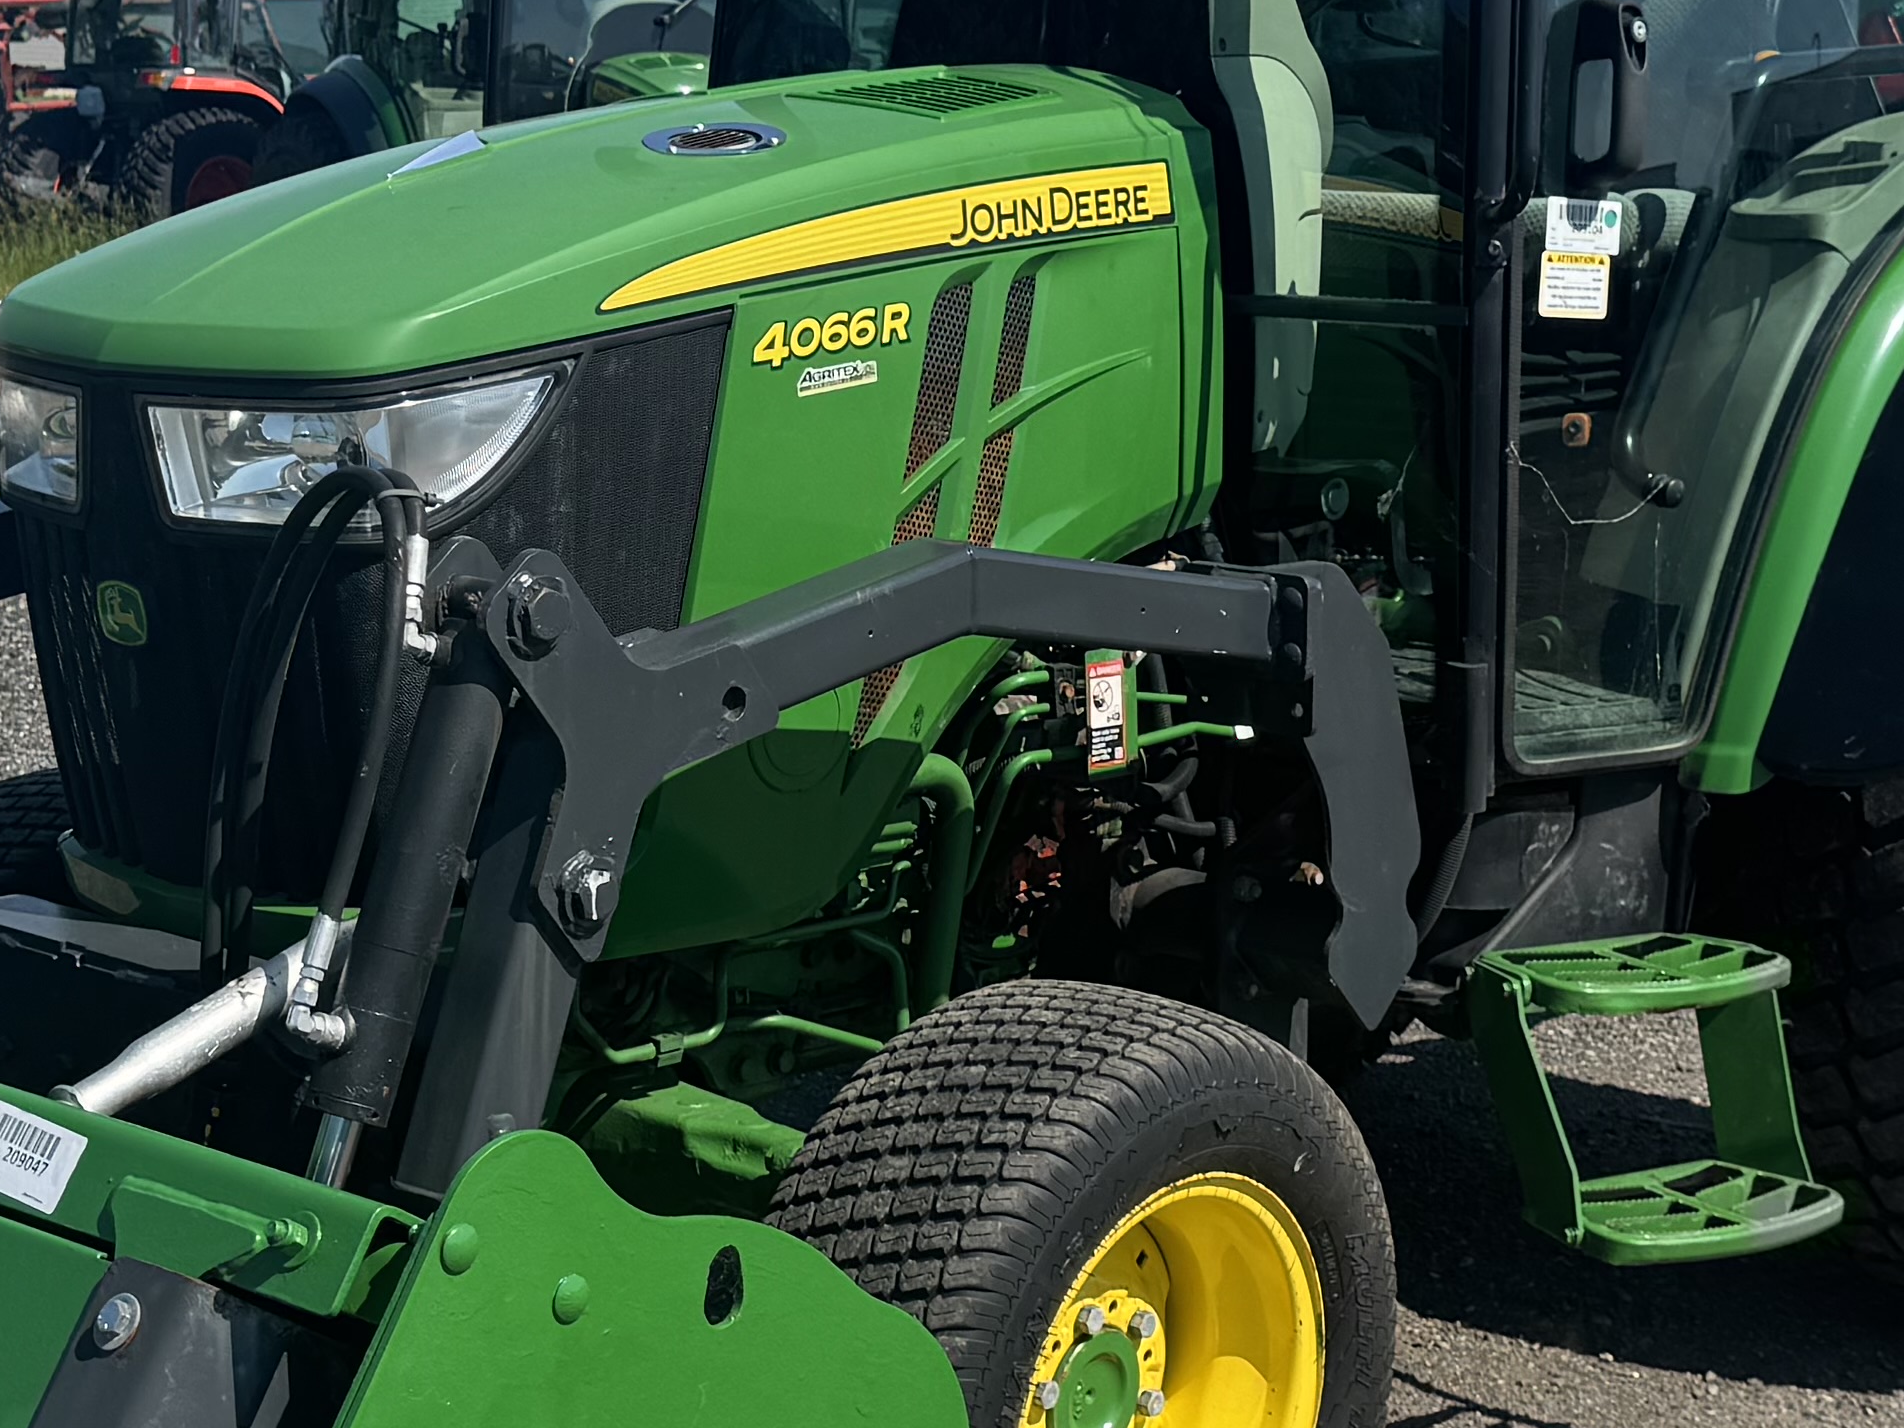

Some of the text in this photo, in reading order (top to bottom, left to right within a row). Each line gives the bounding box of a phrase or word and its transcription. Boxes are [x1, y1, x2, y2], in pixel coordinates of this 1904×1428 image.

[950, 184, 1149, 241] JOHN DEERE
[752, 302, 911, 370] 4066R
[801, 363, 860, 385] AGRITEX
[2, 1146, 49, 1177] 209047
